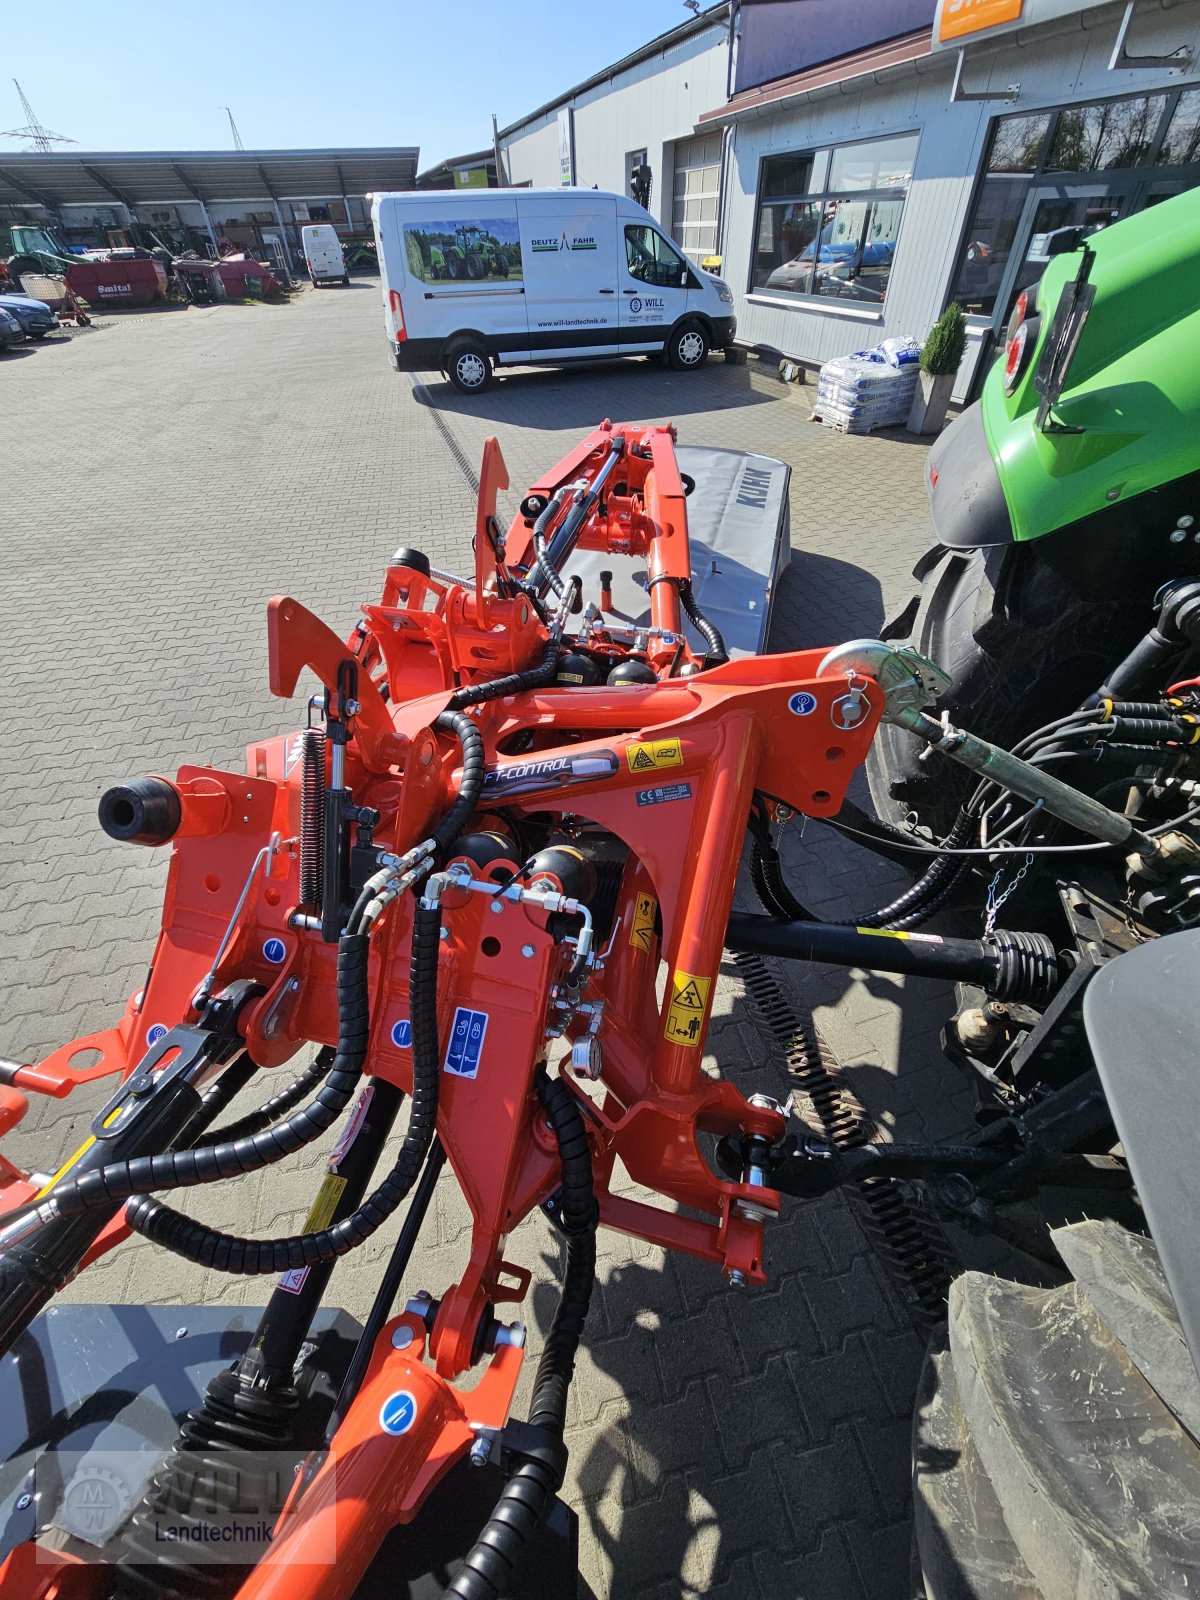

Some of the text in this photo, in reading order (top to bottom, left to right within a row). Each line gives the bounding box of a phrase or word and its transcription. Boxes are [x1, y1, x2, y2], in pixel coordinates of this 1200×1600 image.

[531, 238, 559, 246] DEUTZ
[98, 284, 131, 293] Smital
[644, 298, 665, 307] WILL
[537, 317, 608, 327] www.will-landtechnik.de
[736, 467, 772, 509] KUHN
